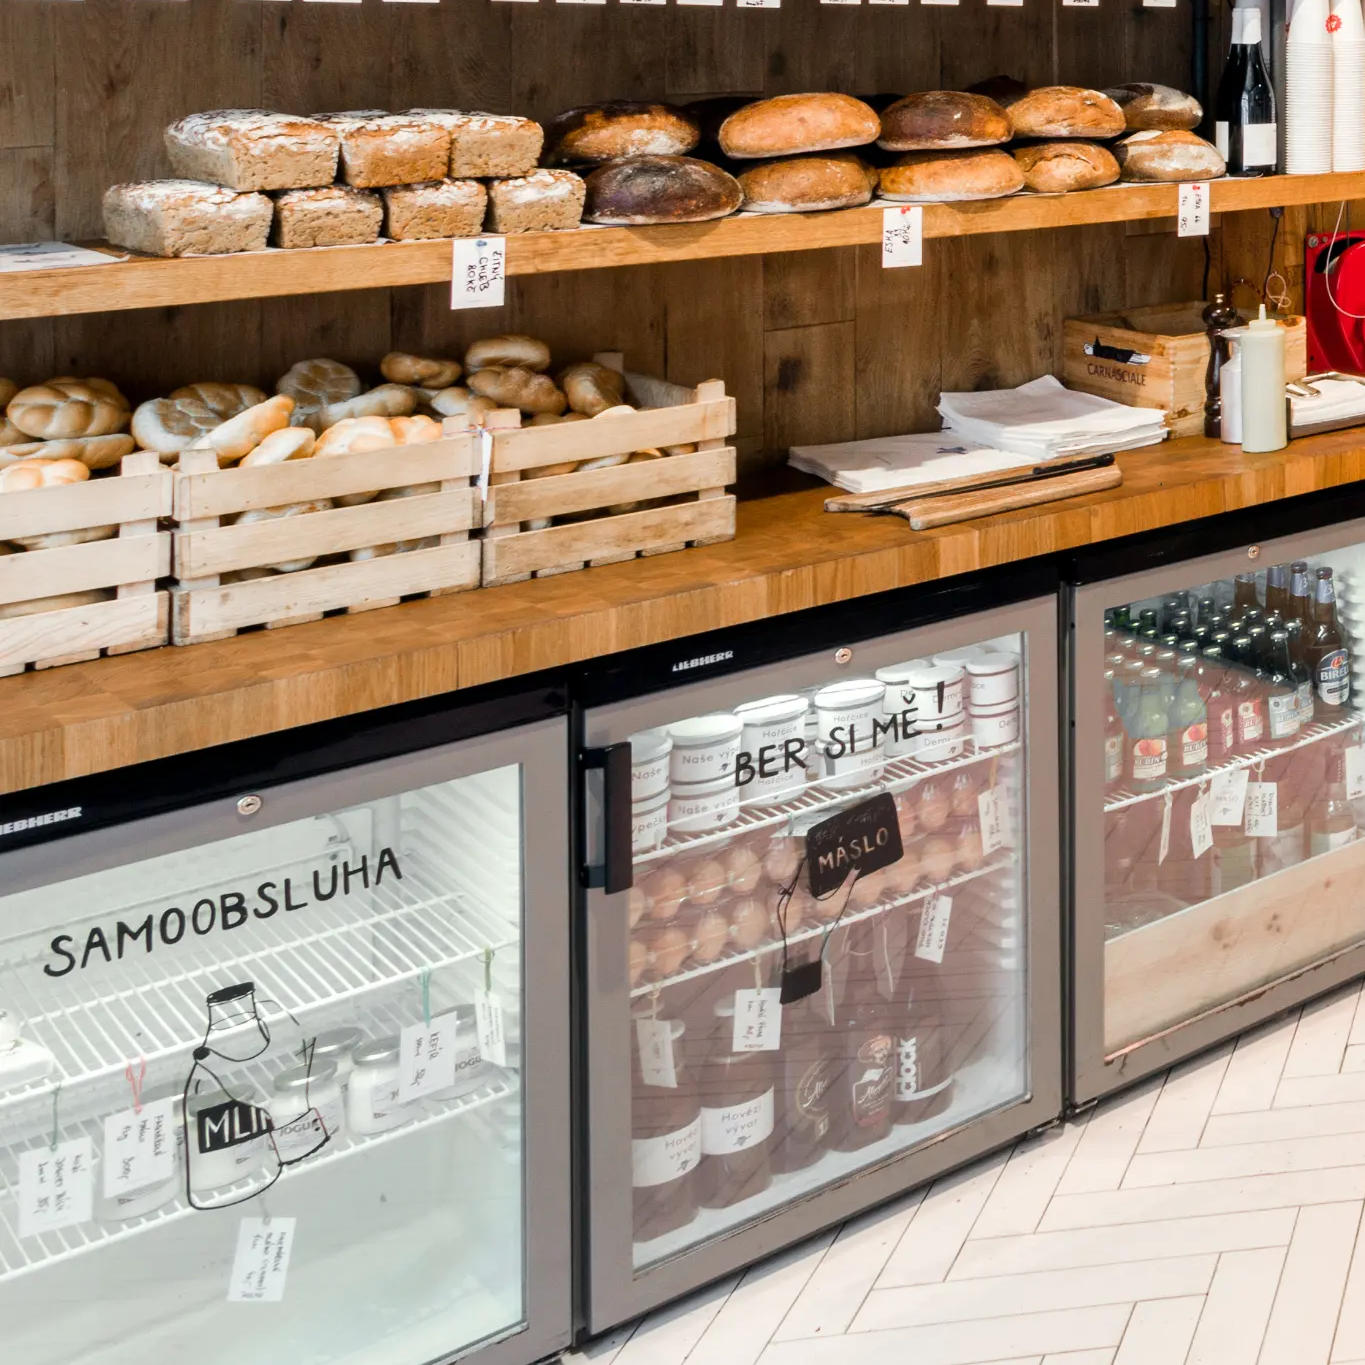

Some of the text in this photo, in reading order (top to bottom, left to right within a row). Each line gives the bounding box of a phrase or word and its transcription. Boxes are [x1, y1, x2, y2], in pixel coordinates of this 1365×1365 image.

[672, 650, 734, 672] LIEBHERR
[682, 751, 714, 764] Naše
[735, 737, 807, 787] BER
[825, 723, 855, 760] SI
[678, 803, 708, 816] Naše
[818, 827, 889, 875] MÁSLO
[43, 847, 404, 977] SAMOOBSLUHA
